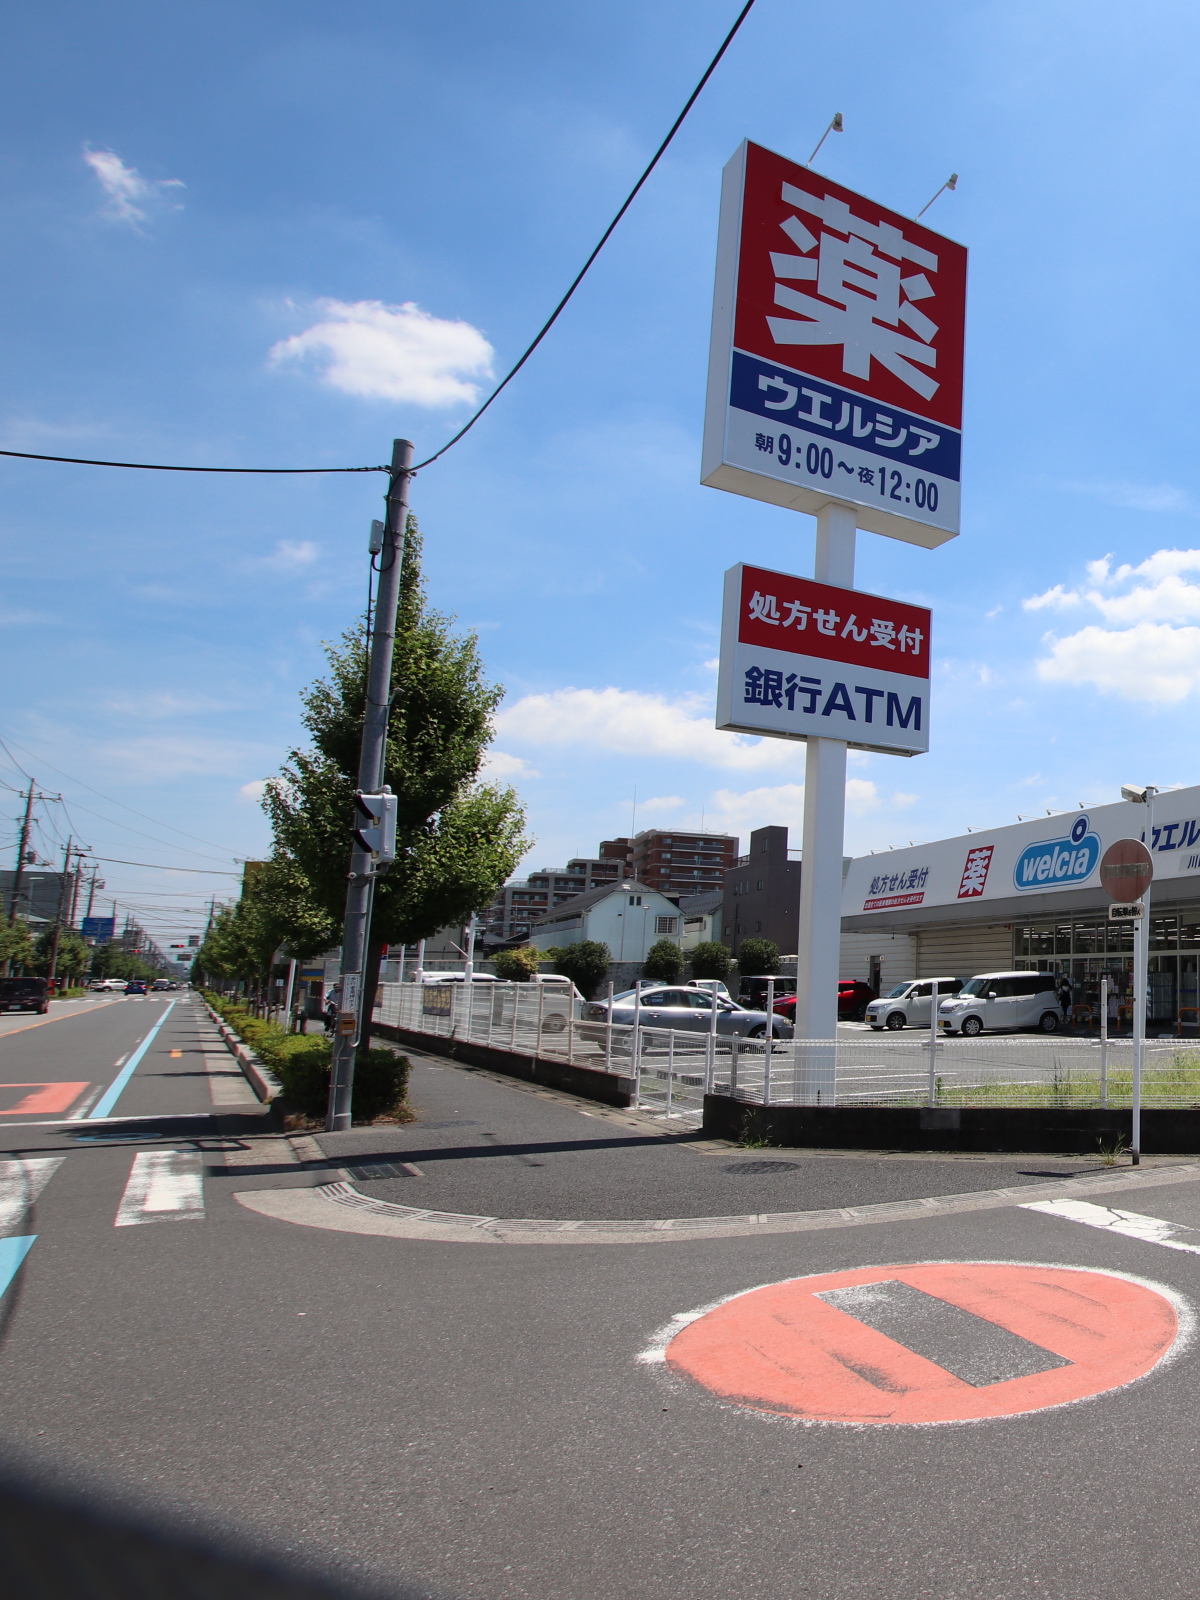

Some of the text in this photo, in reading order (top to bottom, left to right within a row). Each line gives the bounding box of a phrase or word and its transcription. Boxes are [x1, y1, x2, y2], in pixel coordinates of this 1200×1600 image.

[765, 181, 940, 401] 薬
[758, 374, 940, 456] ウエルシア
[748, 590, 924, 655] 処方せん受付
[744, 665, 922, 731] 銀行ATM
[868, 866, 929, 895] 処方せん受付
[960, 849, 991, 895] 薬
[1022, 846, 1090, 882] welcia
